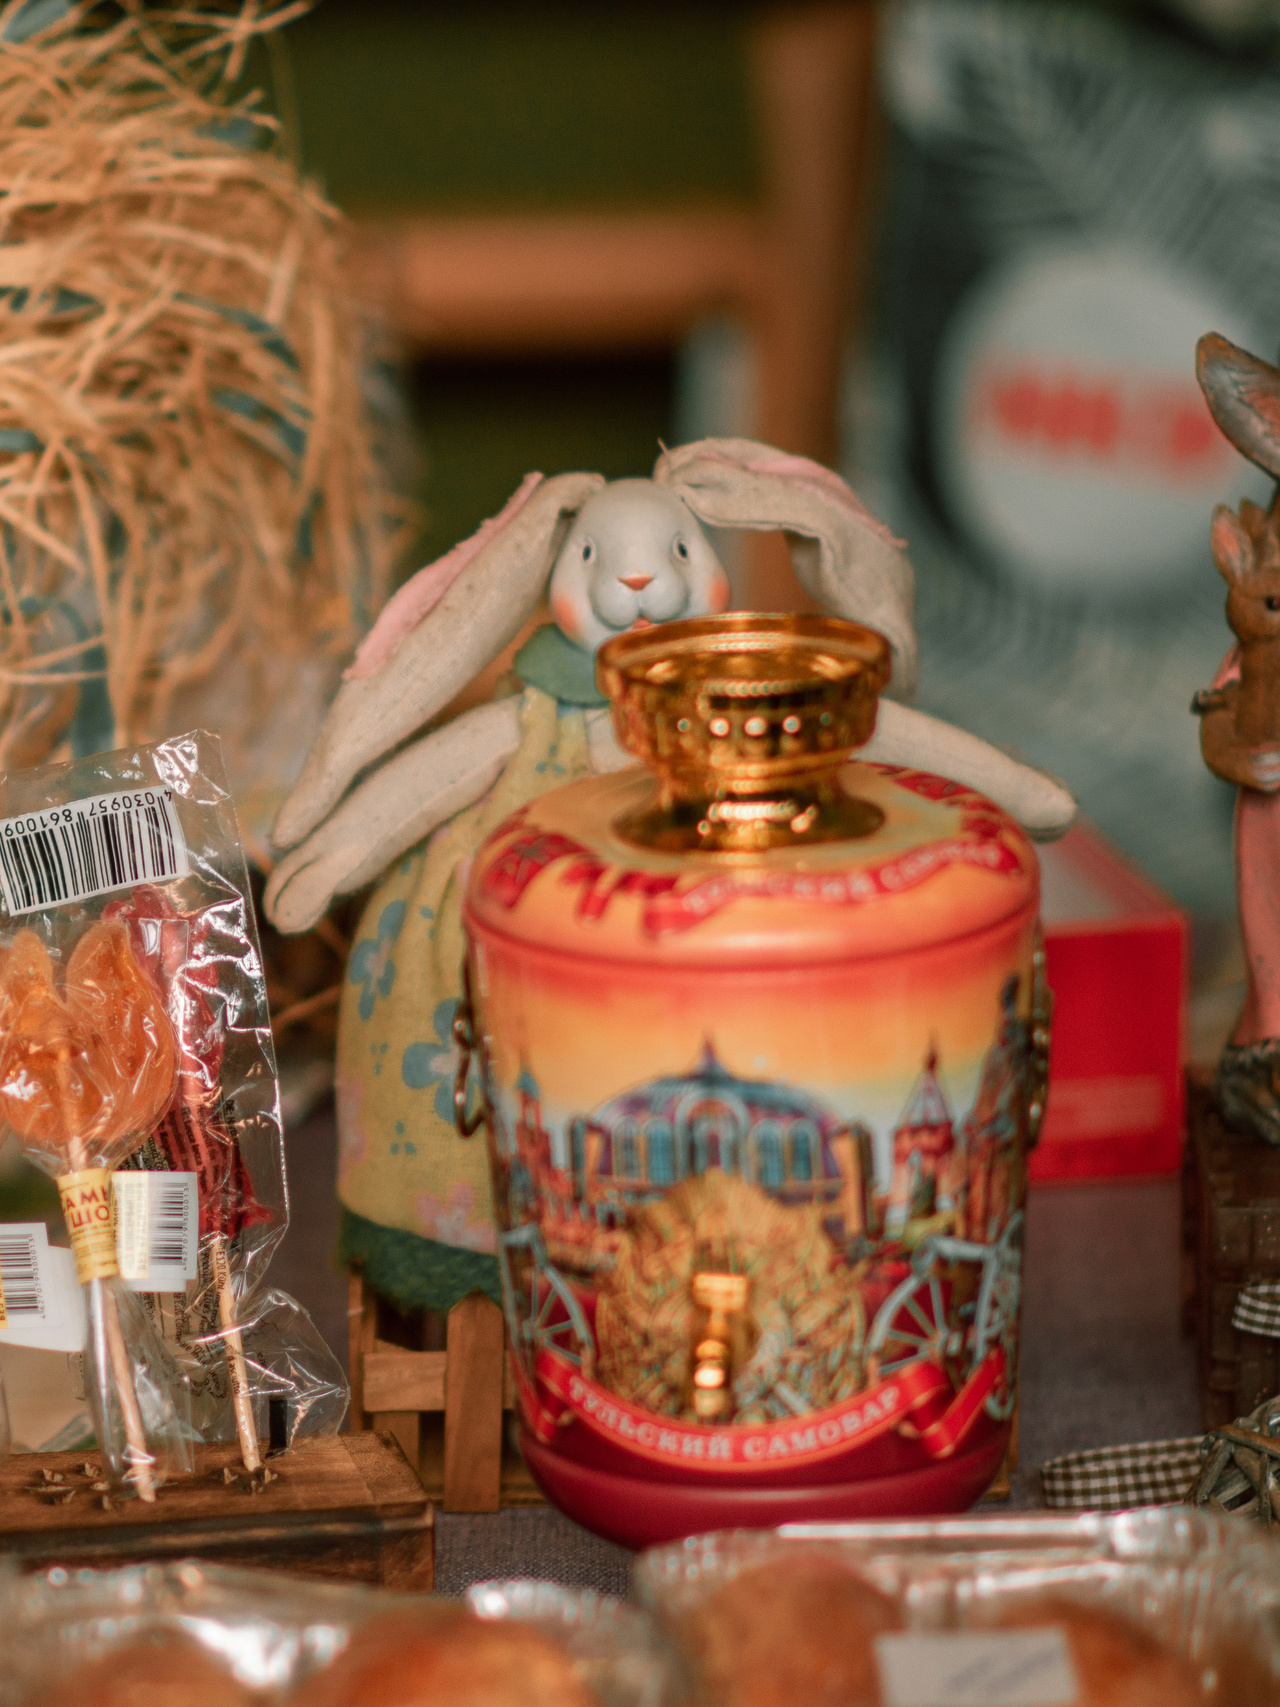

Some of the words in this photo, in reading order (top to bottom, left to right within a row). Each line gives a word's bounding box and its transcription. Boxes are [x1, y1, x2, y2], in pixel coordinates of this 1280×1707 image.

[89, 791, 156, 817] 030957
[4, 808, 74, 837] 861009
[742, 1386, 900, 1461] САМОВАР
